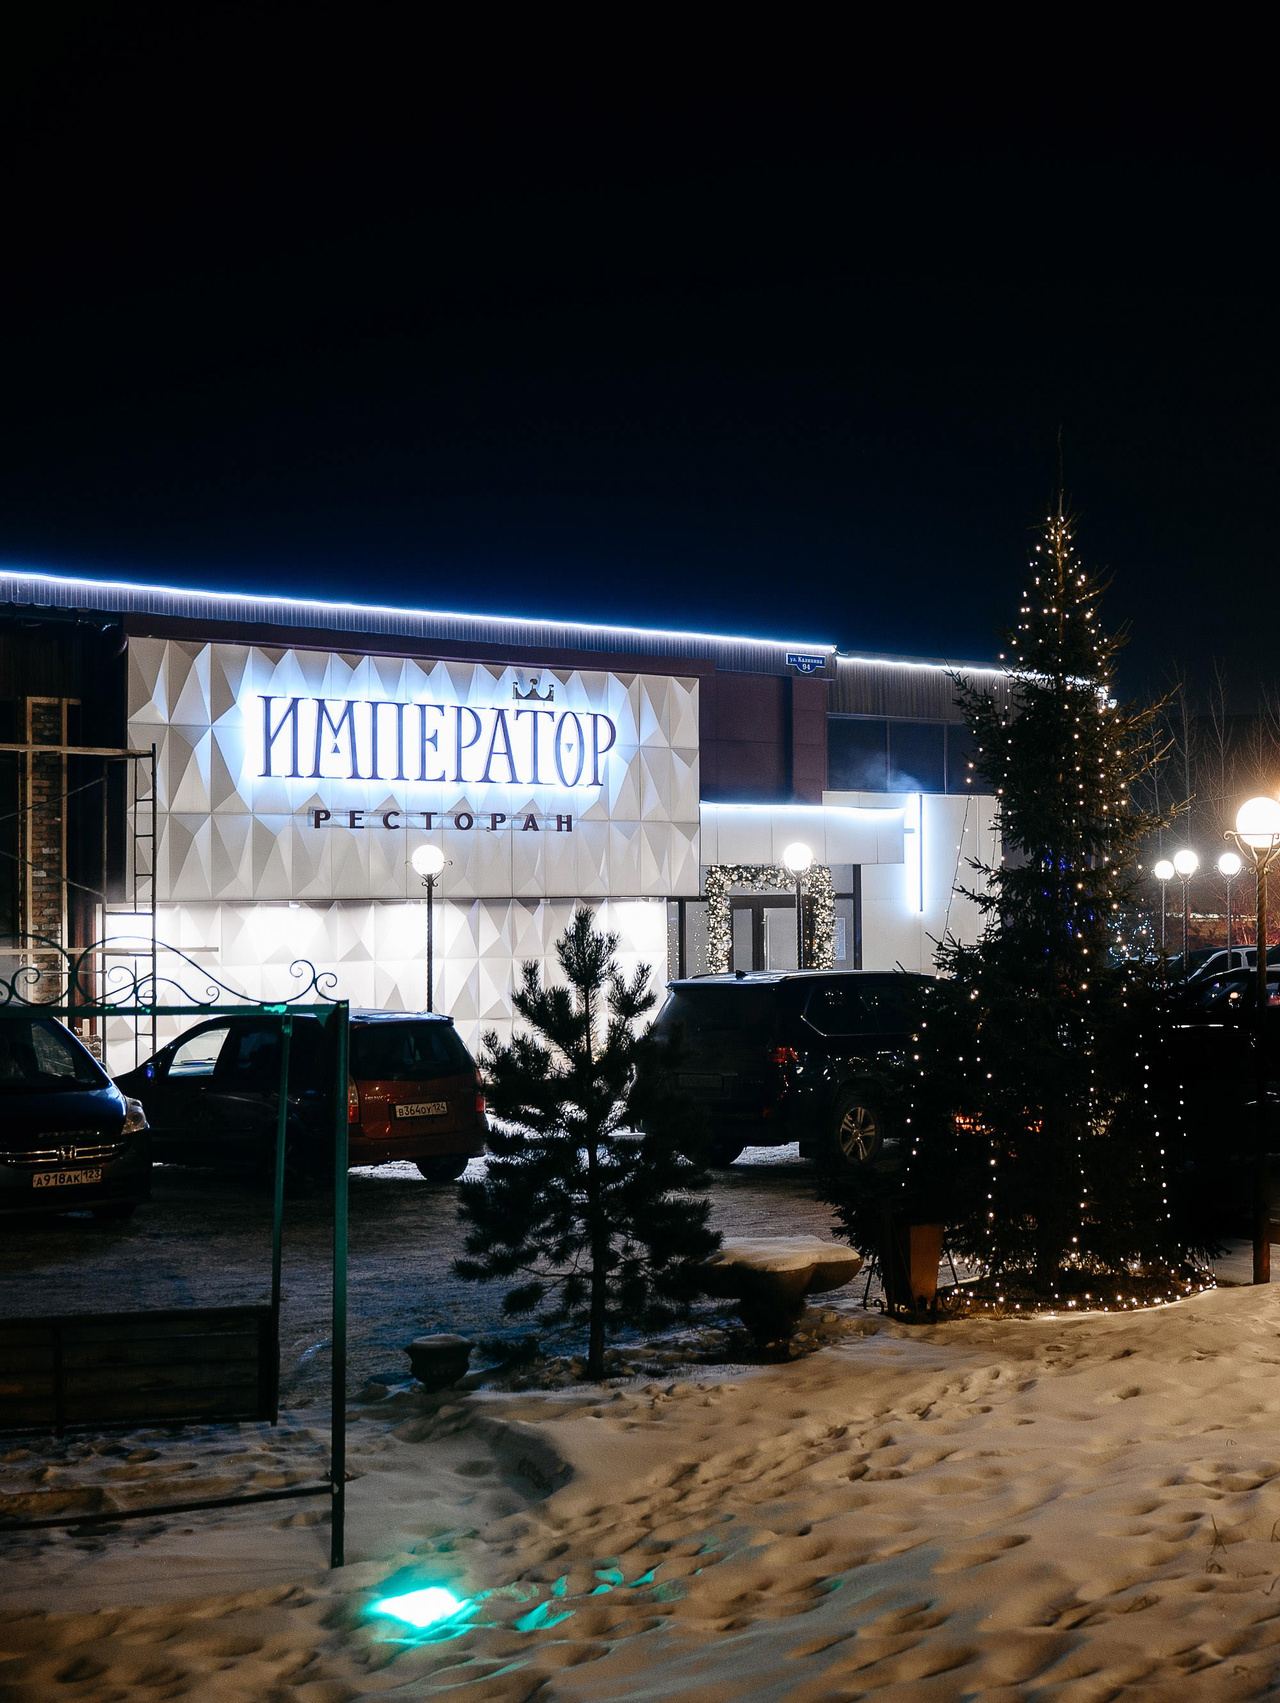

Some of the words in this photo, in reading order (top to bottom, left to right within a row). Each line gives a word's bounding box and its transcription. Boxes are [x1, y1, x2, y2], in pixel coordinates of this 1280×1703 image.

[257, 695, 617, 788] ИМПЕРАТОР
[313, 809, 573, 832] РЕСТОРАН
[433, 1101, 446, 1111] 124
[36, 1173, 80, 1187] А918АК
[84, 1170, 100, 1179] 123
